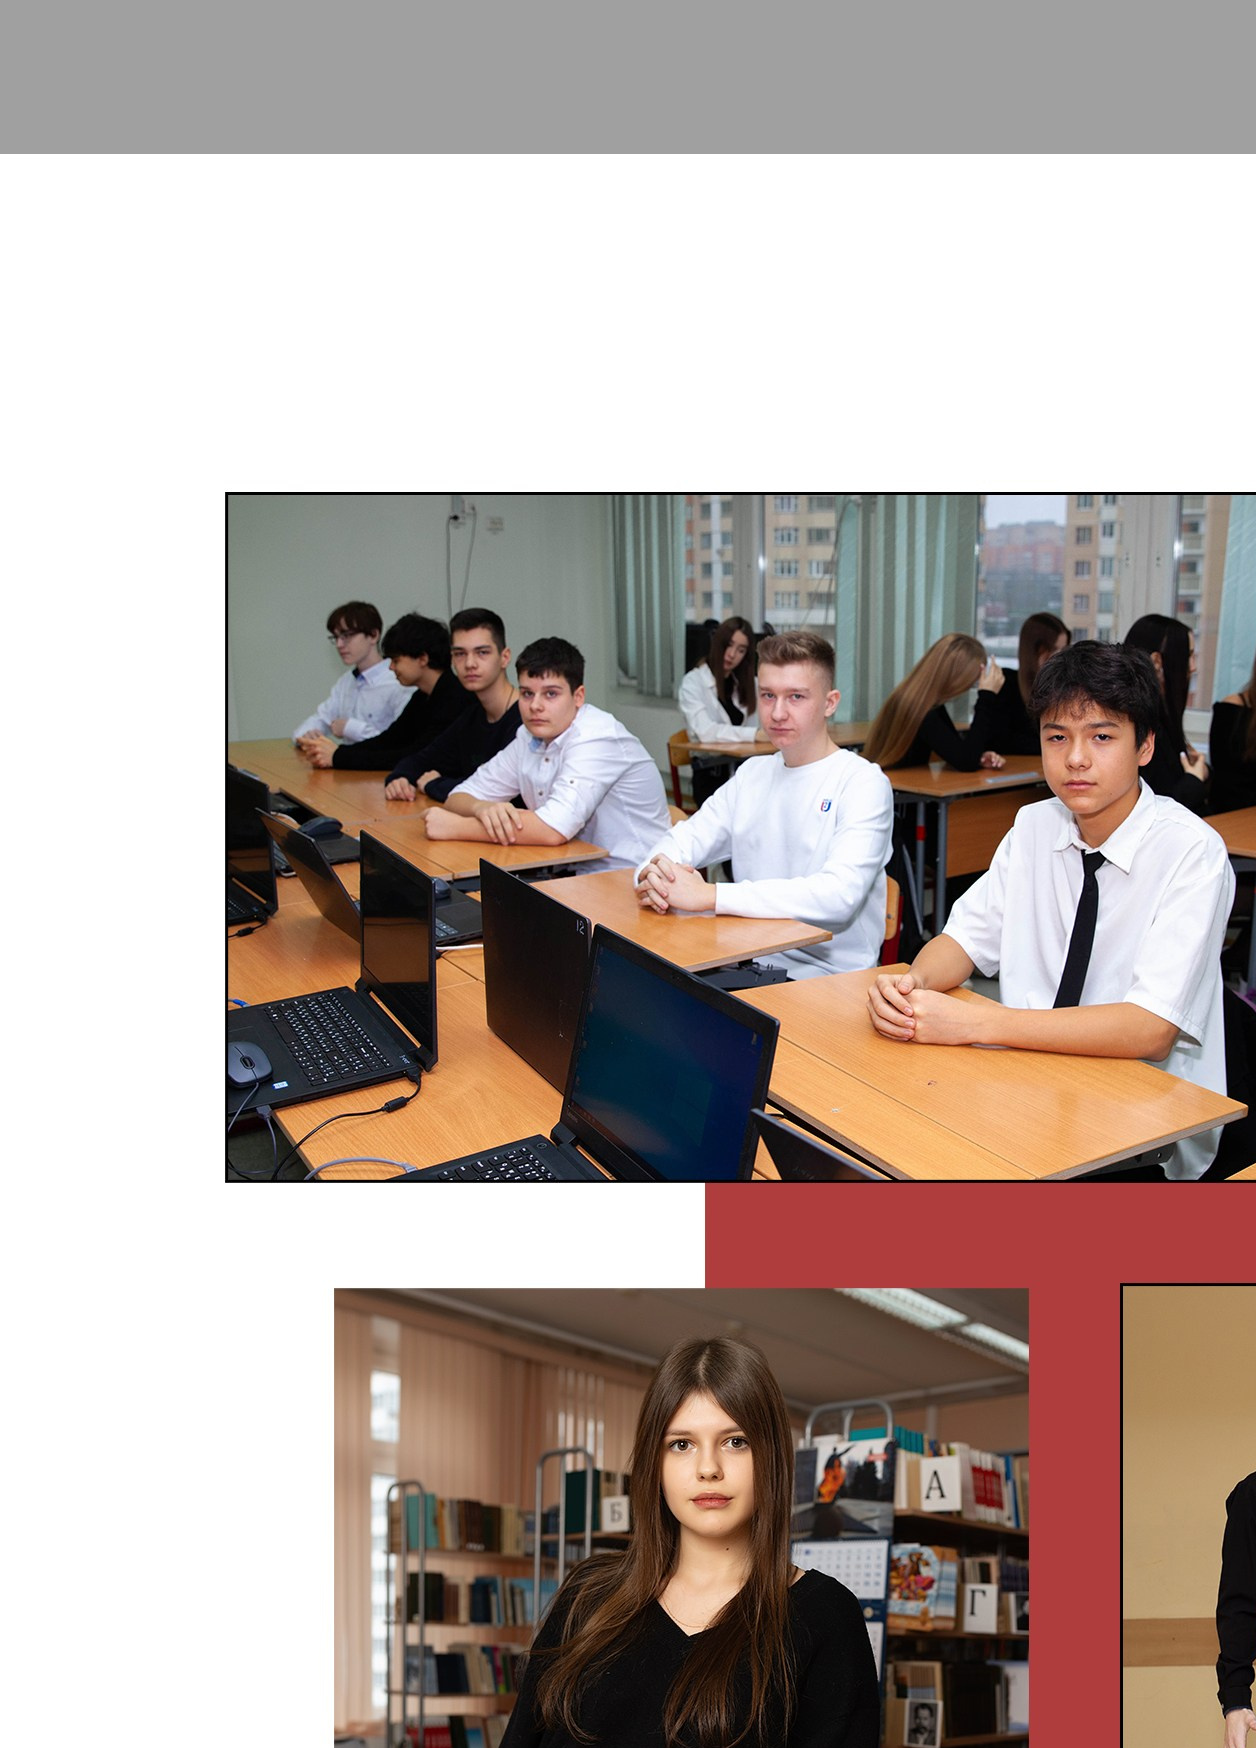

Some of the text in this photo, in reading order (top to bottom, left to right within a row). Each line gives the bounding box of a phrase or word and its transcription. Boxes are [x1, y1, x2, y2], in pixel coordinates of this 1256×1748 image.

[925, 1470, 946, 1500] А
[610, 1502, 623, 1523] Б
[969, 1589, 986, 1617] Г
